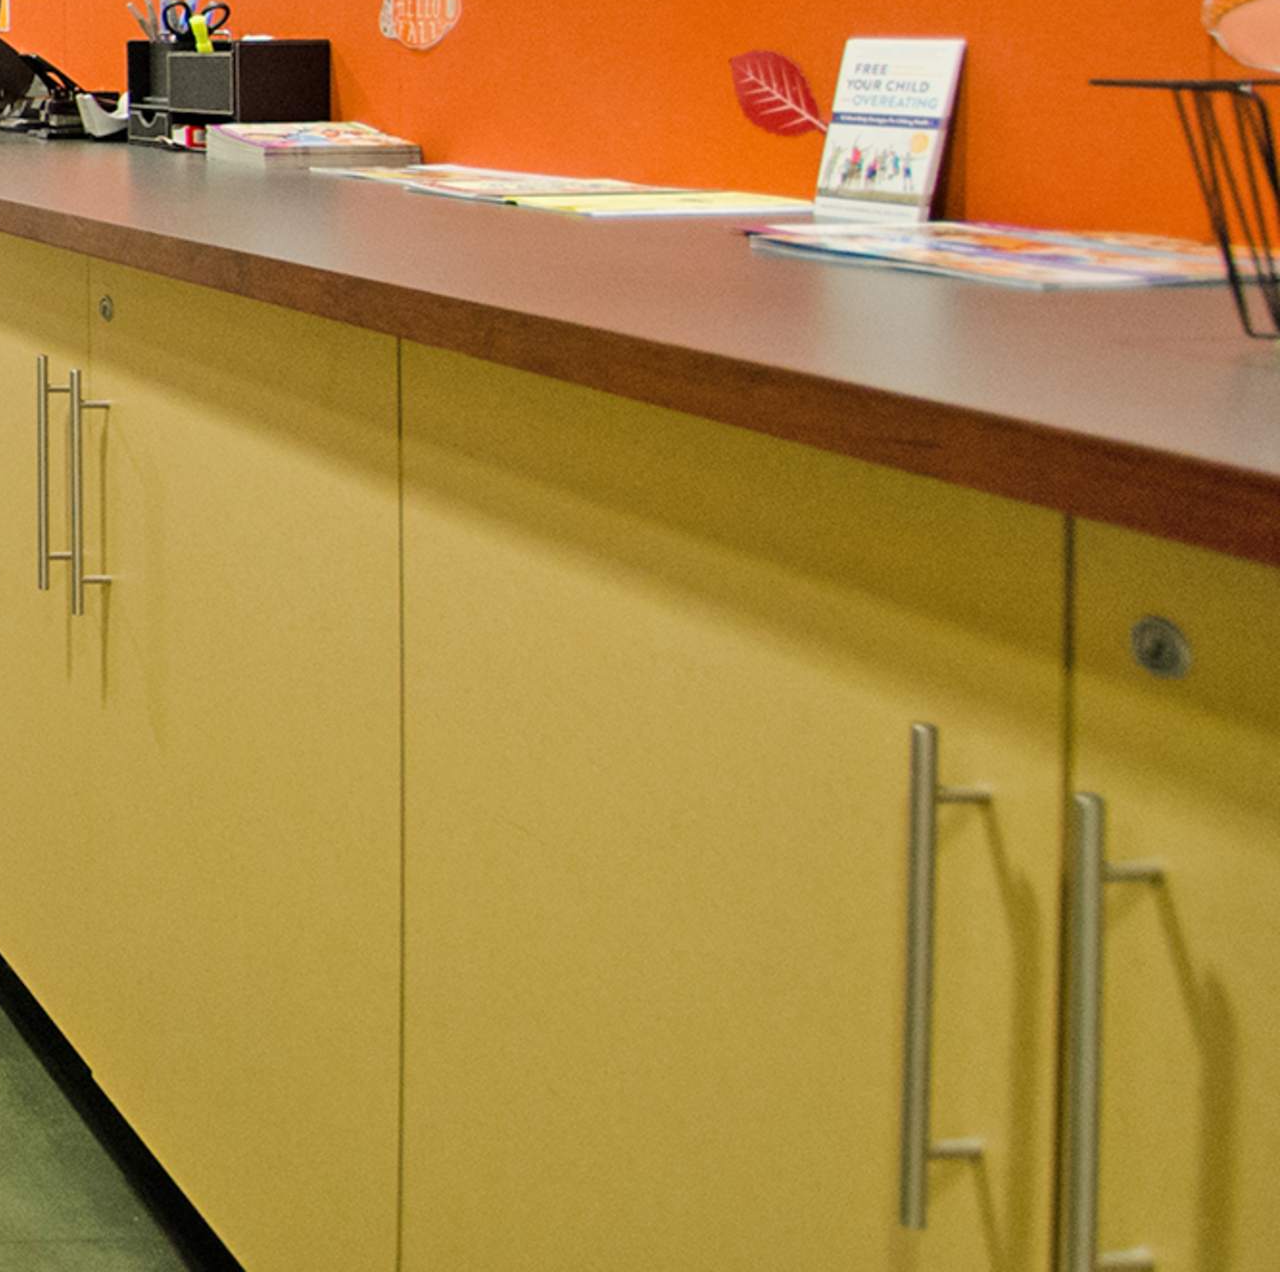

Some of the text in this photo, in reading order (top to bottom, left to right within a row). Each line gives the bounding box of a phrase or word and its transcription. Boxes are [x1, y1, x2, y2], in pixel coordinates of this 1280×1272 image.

[397, 19, 438, 44] FALL
[854, 63, 889, 76] FREE
[847, 79, 930, 94] YOUR CHILD
[851, 94, 939, 110] OVEREATING
